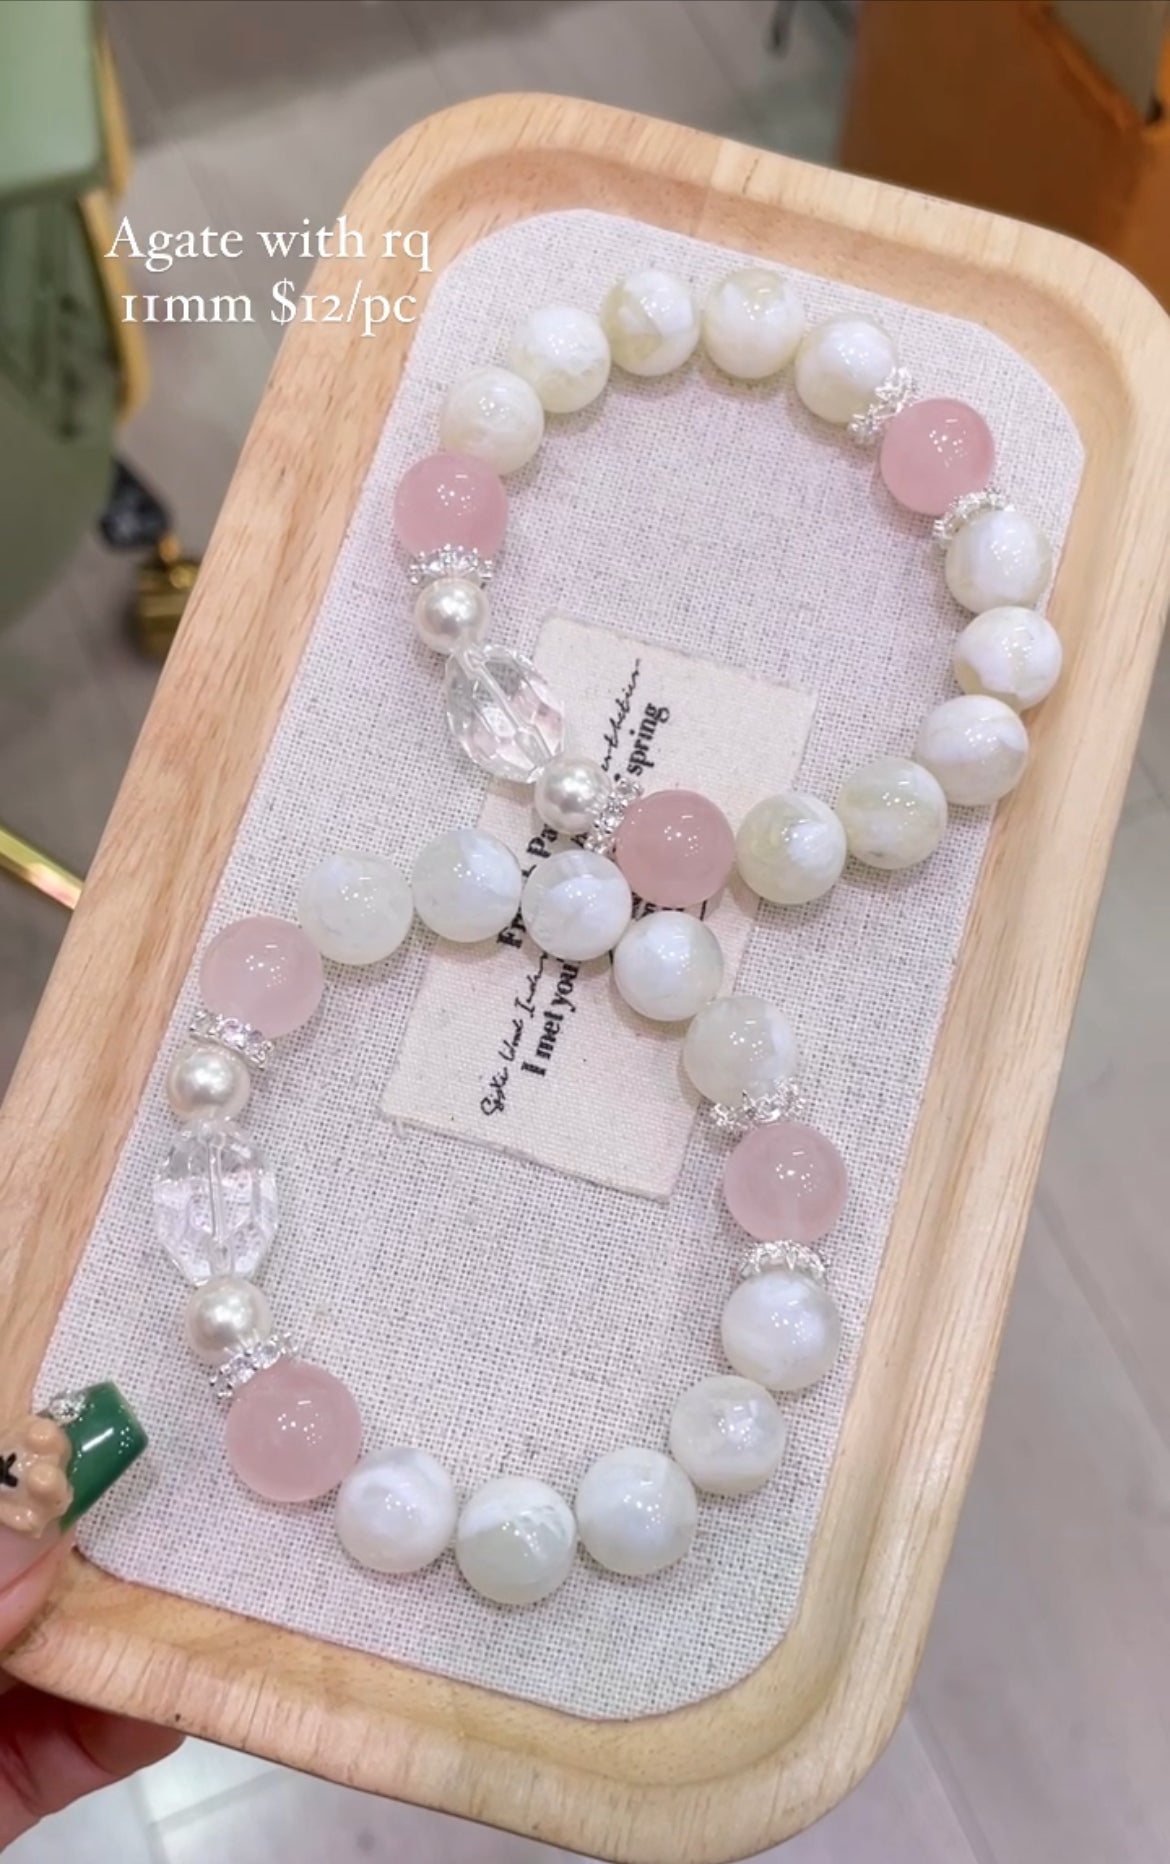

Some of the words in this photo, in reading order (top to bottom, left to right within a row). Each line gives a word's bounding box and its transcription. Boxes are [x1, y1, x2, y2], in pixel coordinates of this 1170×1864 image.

[520, 1061, 547, 1077] I
[535, 1010, 565, 1061] met
[626, 702, 671, 777] spring
